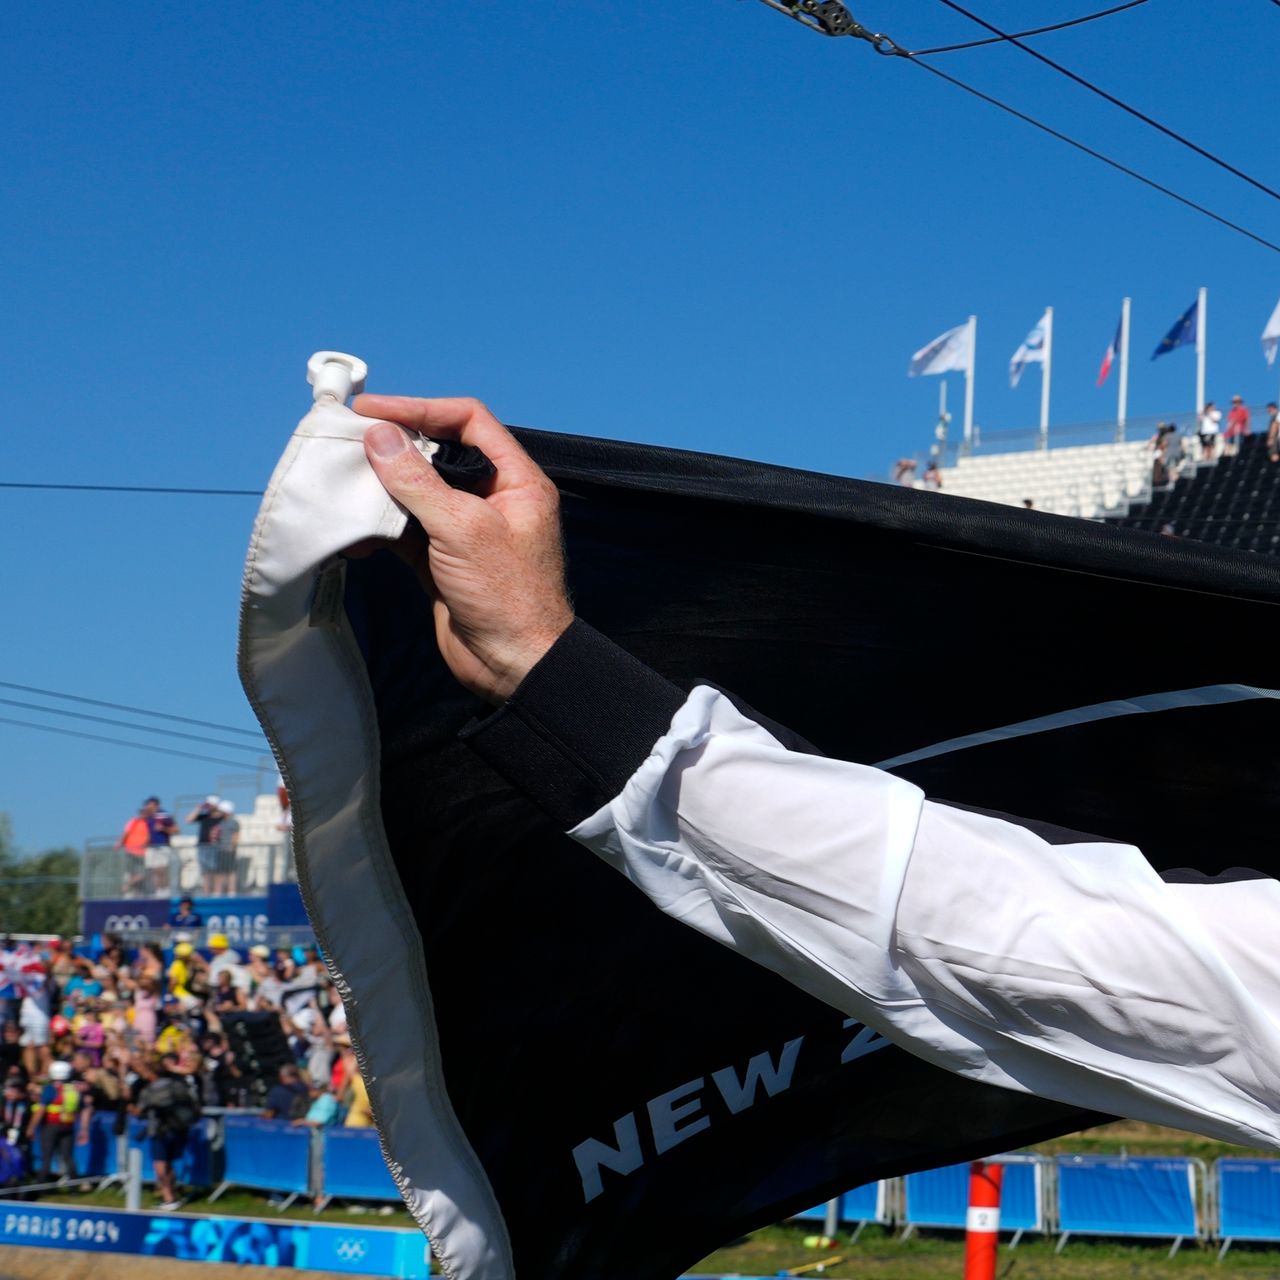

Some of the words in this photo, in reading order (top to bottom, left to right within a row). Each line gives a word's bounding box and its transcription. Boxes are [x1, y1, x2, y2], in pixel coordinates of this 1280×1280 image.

[572, 1034, 805, 1204] NEW
[5, 1213, 61, 1239] PARIS
[65, 1218, 120, 1243] 2024
